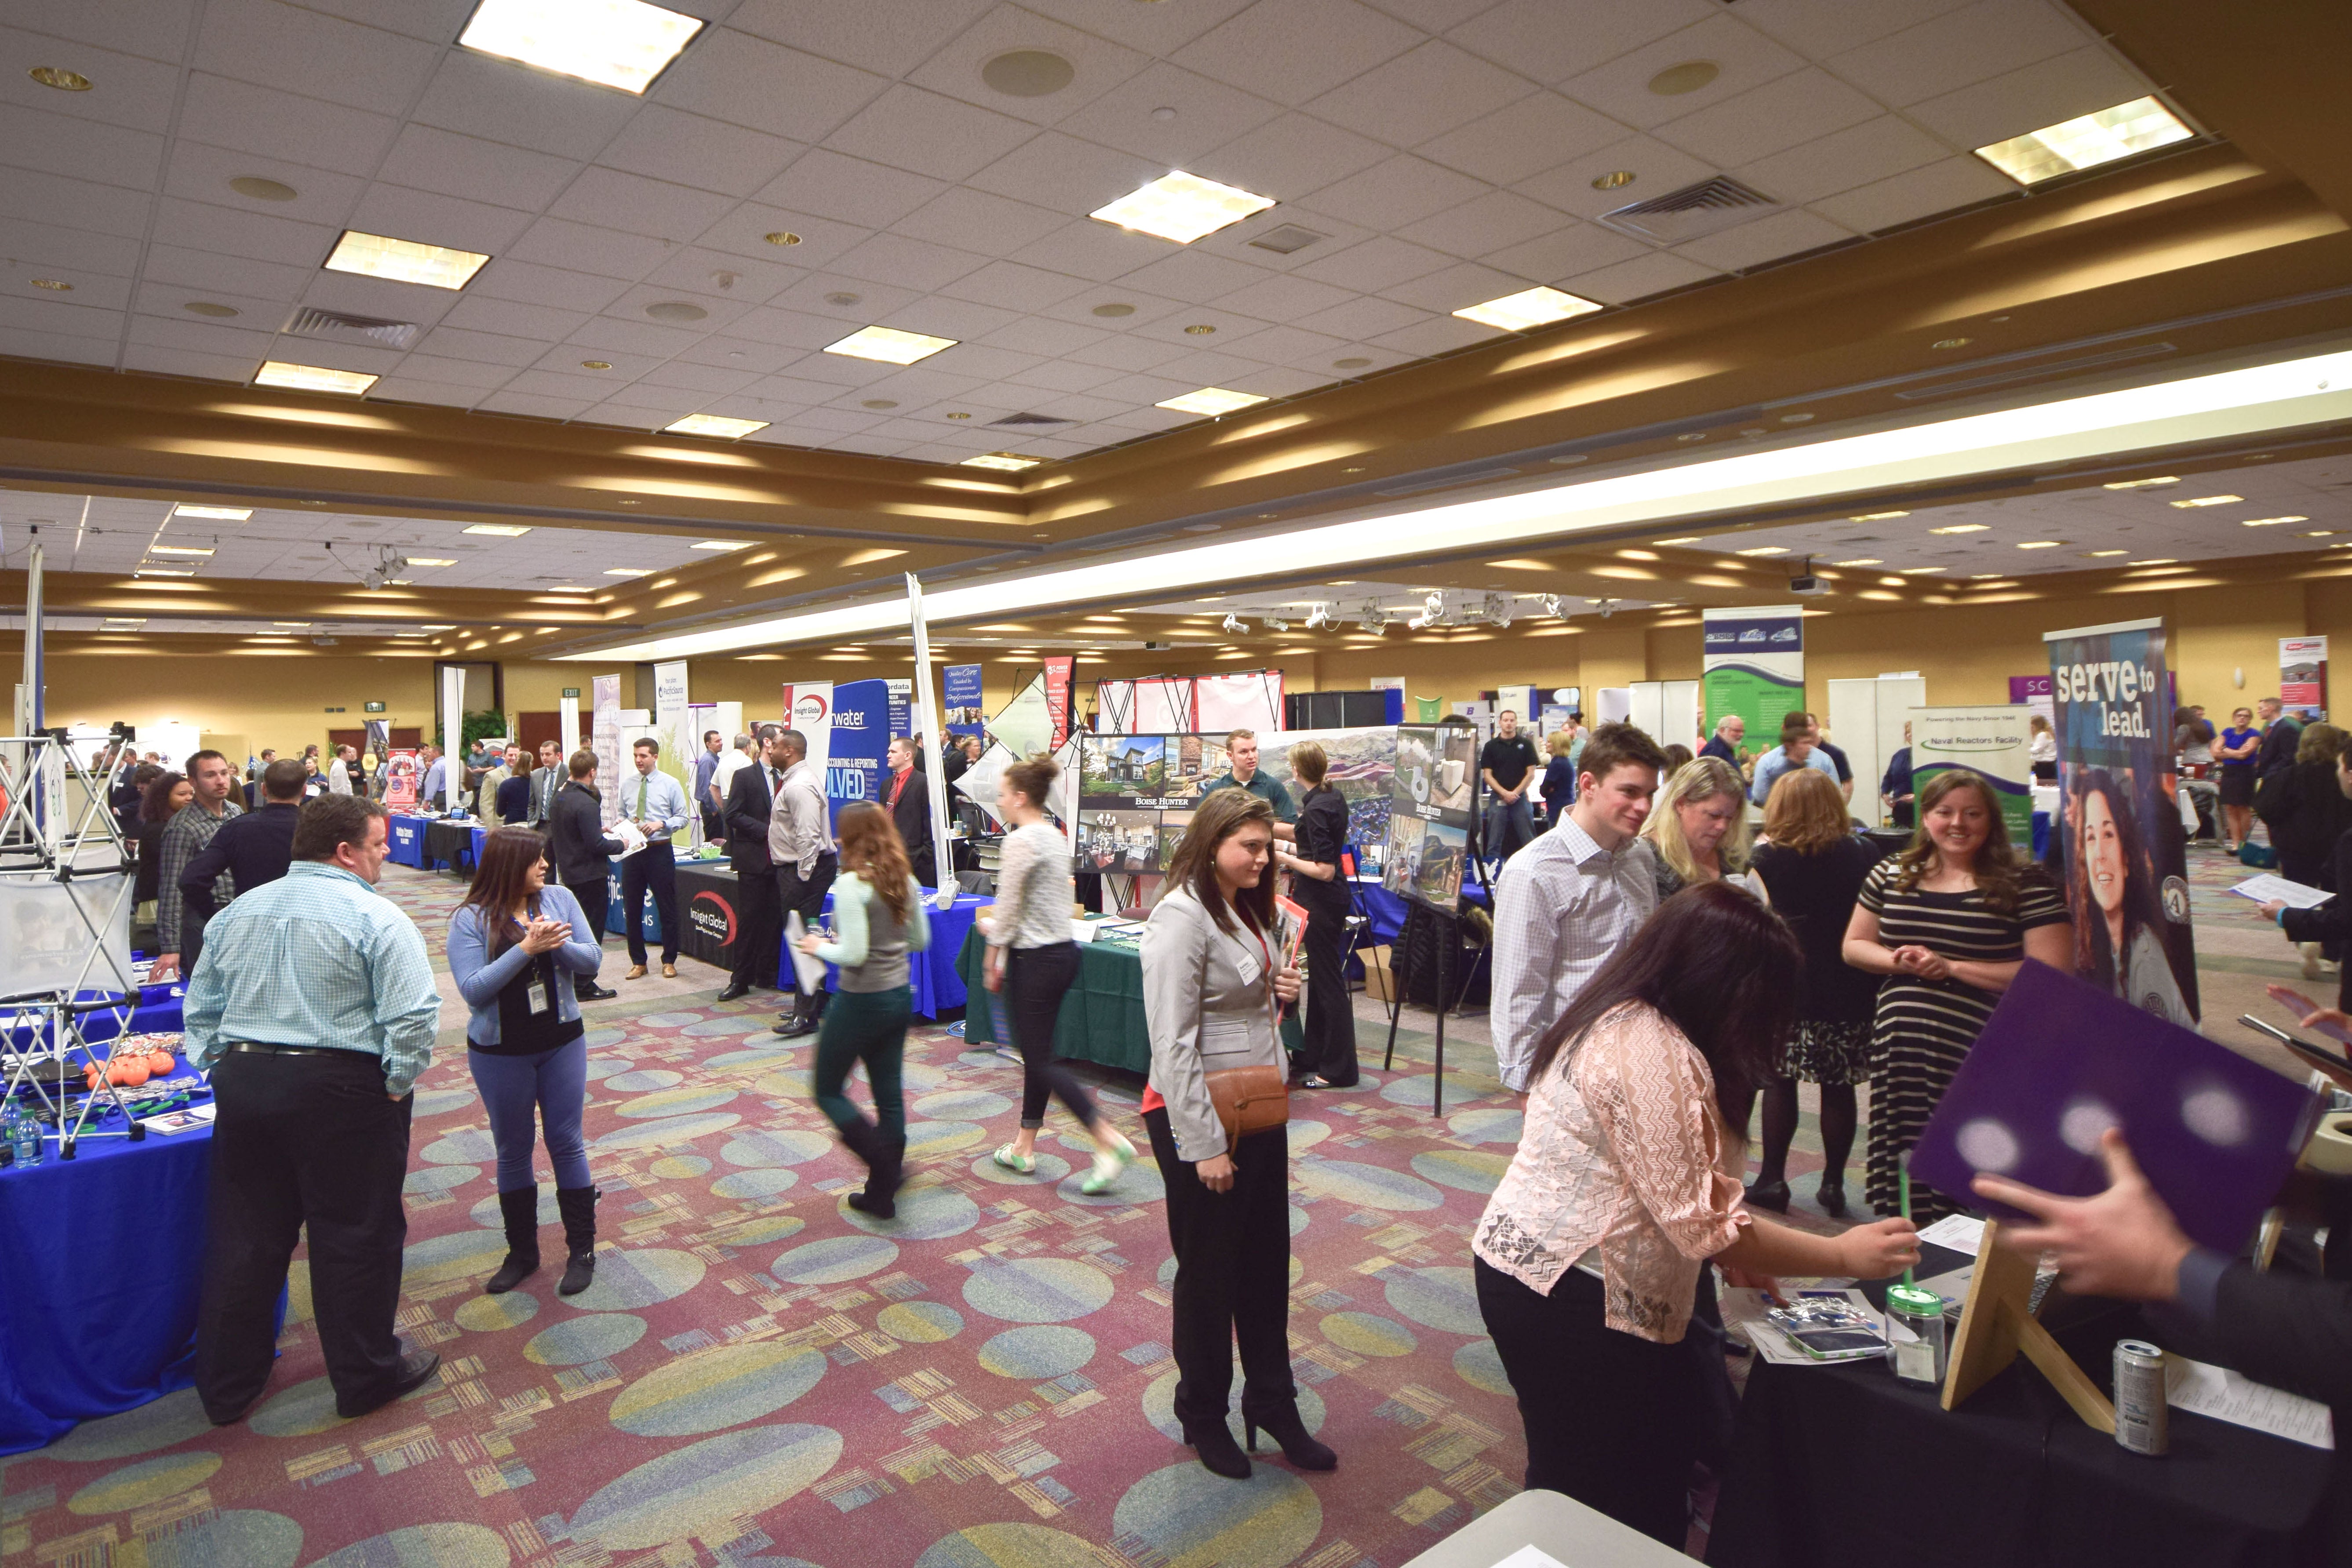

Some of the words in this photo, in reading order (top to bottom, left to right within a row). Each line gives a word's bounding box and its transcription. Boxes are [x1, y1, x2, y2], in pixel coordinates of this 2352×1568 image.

[962, 668, 978, 676] Care
[2057, 660, 2138, 702] serve
[2140, 665, 2155, 692] to
[664, 686, 683, 696] PacificSource
[946, 692, 981, 703] Professionals
[794, 707, 807, 715] Insight
[2101, 702, 2150, 738] lead.
[1995, 736, 2022, 745] Facility
[851, 758, 854, 768] &
[855, 758, 877, 768] REPORTING
[691, 907, 708, 924] Insight
[708, 914, 727, 931] Global
